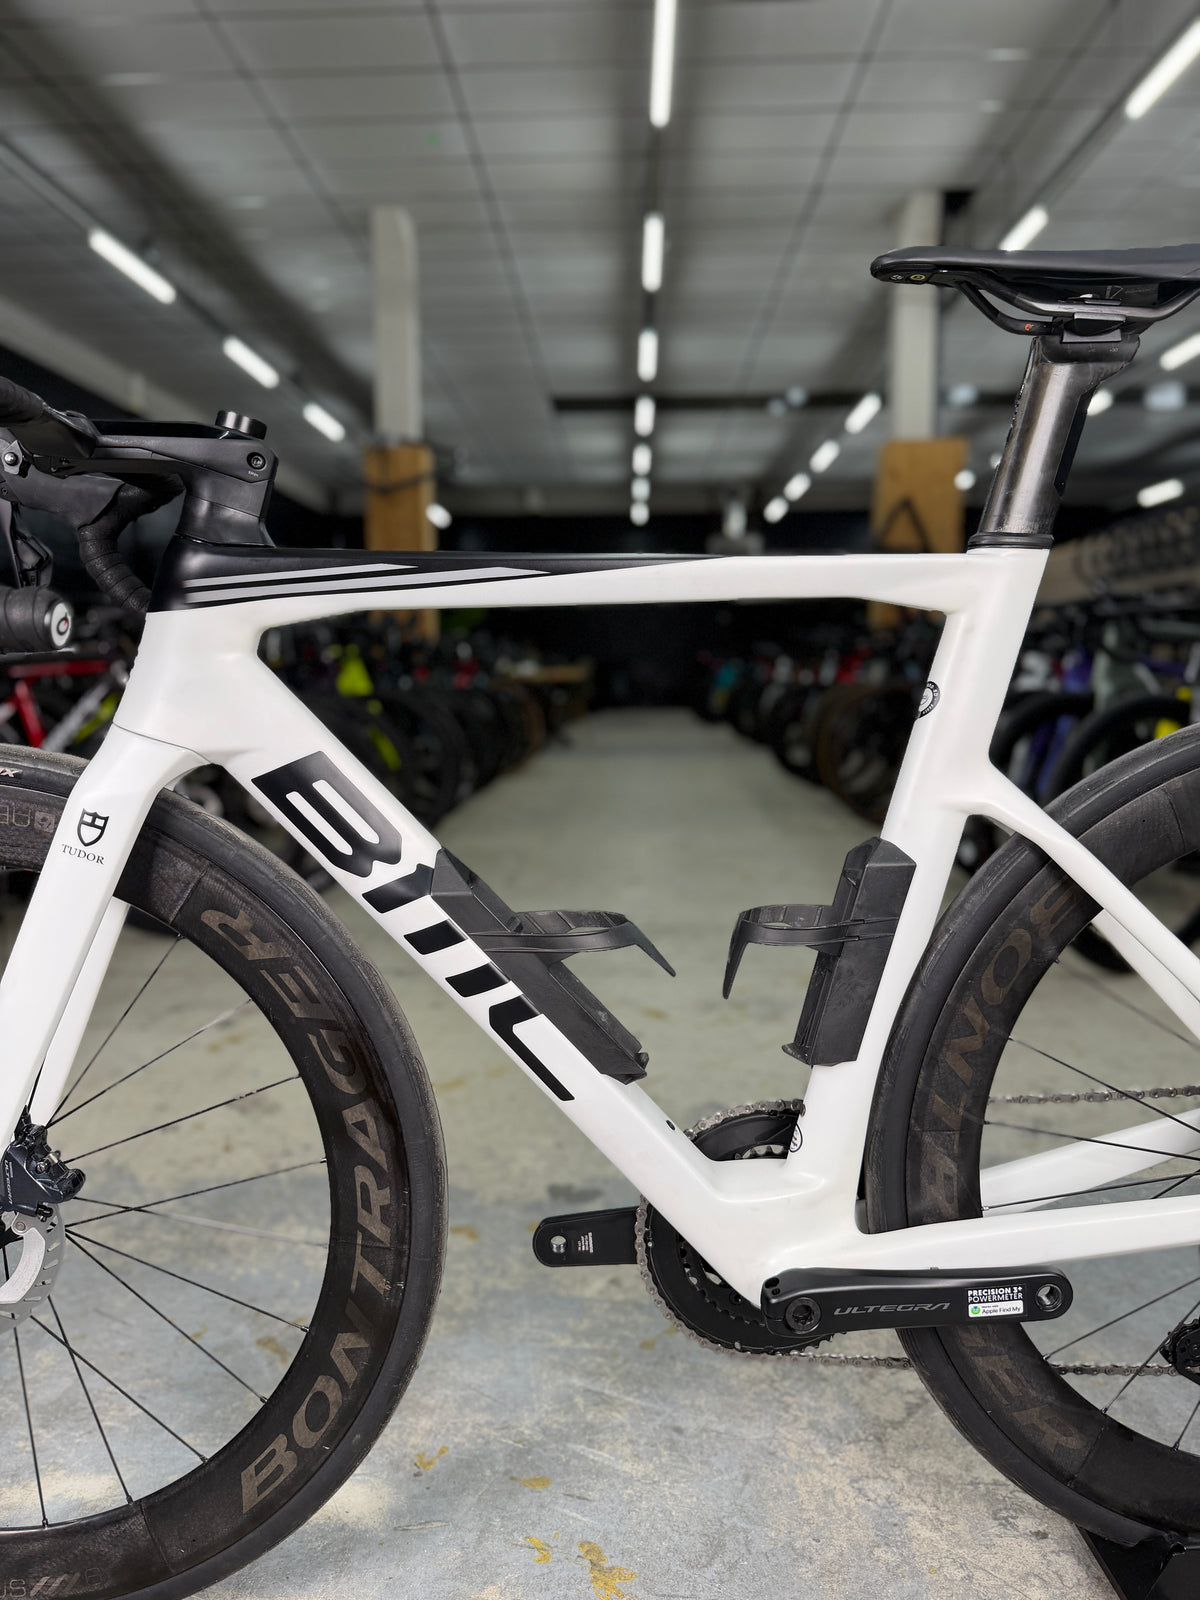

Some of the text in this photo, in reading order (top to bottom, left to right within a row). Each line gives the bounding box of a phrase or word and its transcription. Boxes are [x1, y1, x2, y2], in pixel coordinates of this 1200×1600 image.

[62, 843, 105, 865] TUDOR
[200, 909, 392, 1514] BONTRAGER
[967, 1287, 1011, 1297] PRECISION
[968, 1292, 1023, 1303] POWERMETER
[833, 1302, 951, 1316] ULTEGRA
